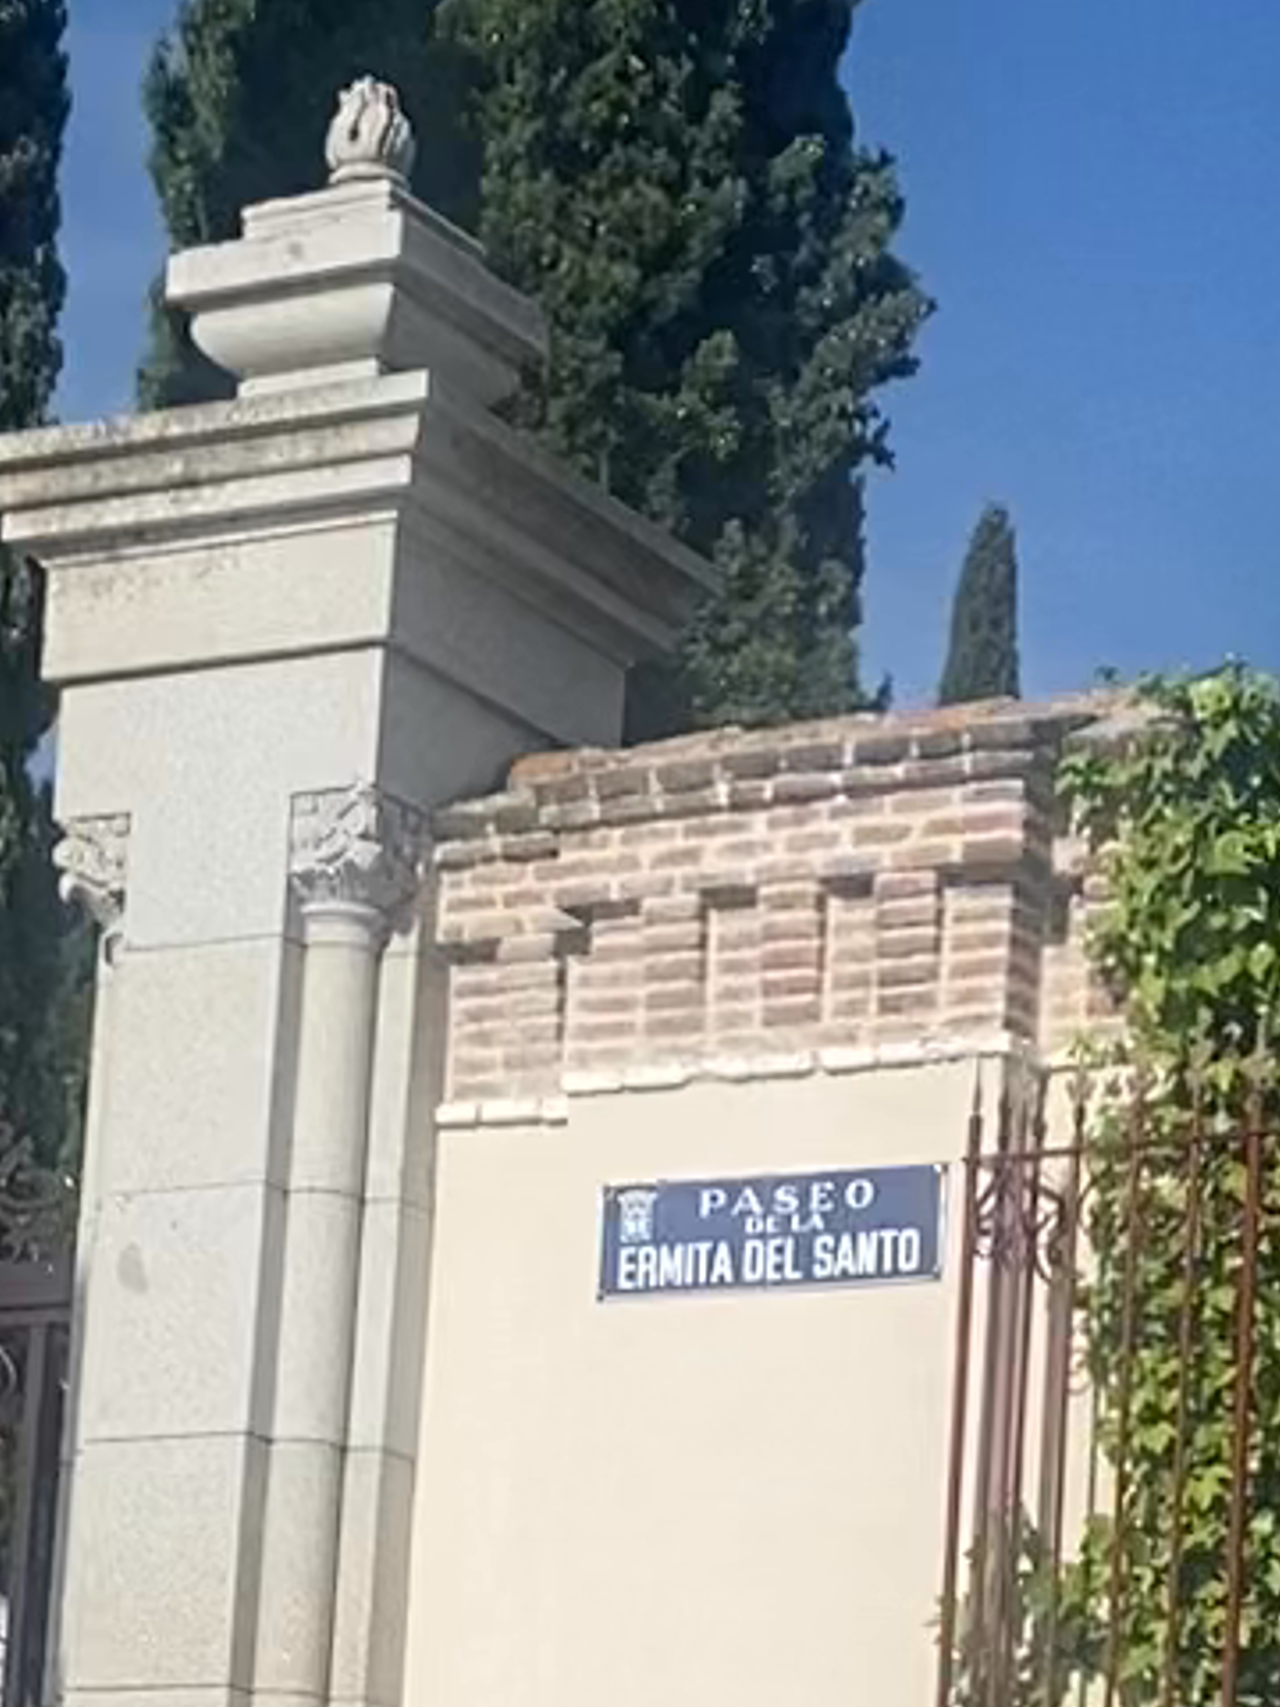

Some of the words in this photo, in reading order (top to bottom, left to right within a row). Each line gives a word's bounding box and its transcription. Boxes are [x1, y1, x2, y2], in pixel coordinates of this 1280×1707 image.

[699, 1179, 876, 1218] PASEO
[744, 1216, 781, 1235] DE
[791, 1213, 826, 1232] LA
[617, 1241, 734, 1291] ERMITA
[742, 1237, 804, 1284] DEL
[812, 1228, 921, 1280] SANTO
